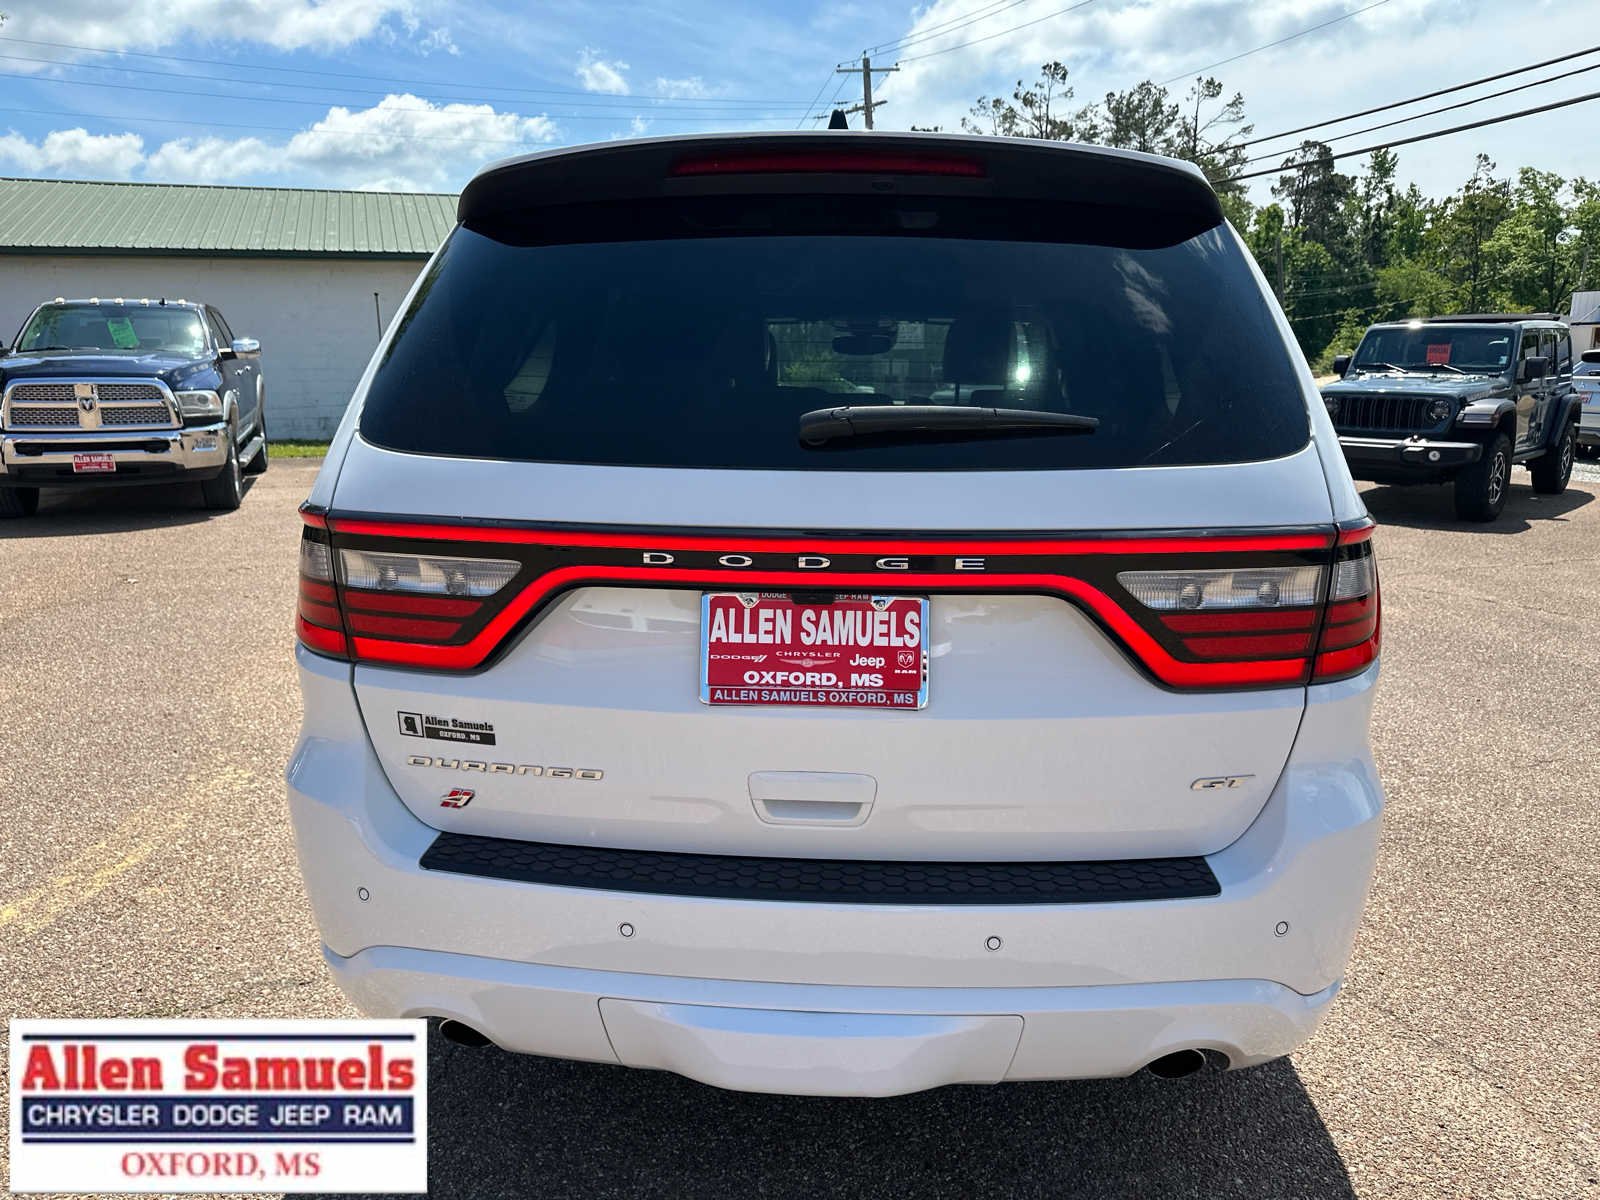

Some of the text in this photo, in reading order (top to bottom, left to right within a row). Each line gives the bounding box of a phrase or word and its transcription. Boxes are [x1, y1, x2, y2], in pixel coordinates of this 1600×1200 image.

[642, 552, 986, 570] DODGE
[710, 608, 920, 648] ALLEN SAMUELS
[850, 654, 886, 668] Jeep
[743, 671, 884, 689] OXFORD, MS
[714, 689, 914, 705] ALLEN SAMUELS OXFORD, MS
[424, 716, 494, 732] Allen Samuels
[407, 755, 604, 781] DURANGO
[1190, 774, 1256, 791] GT
